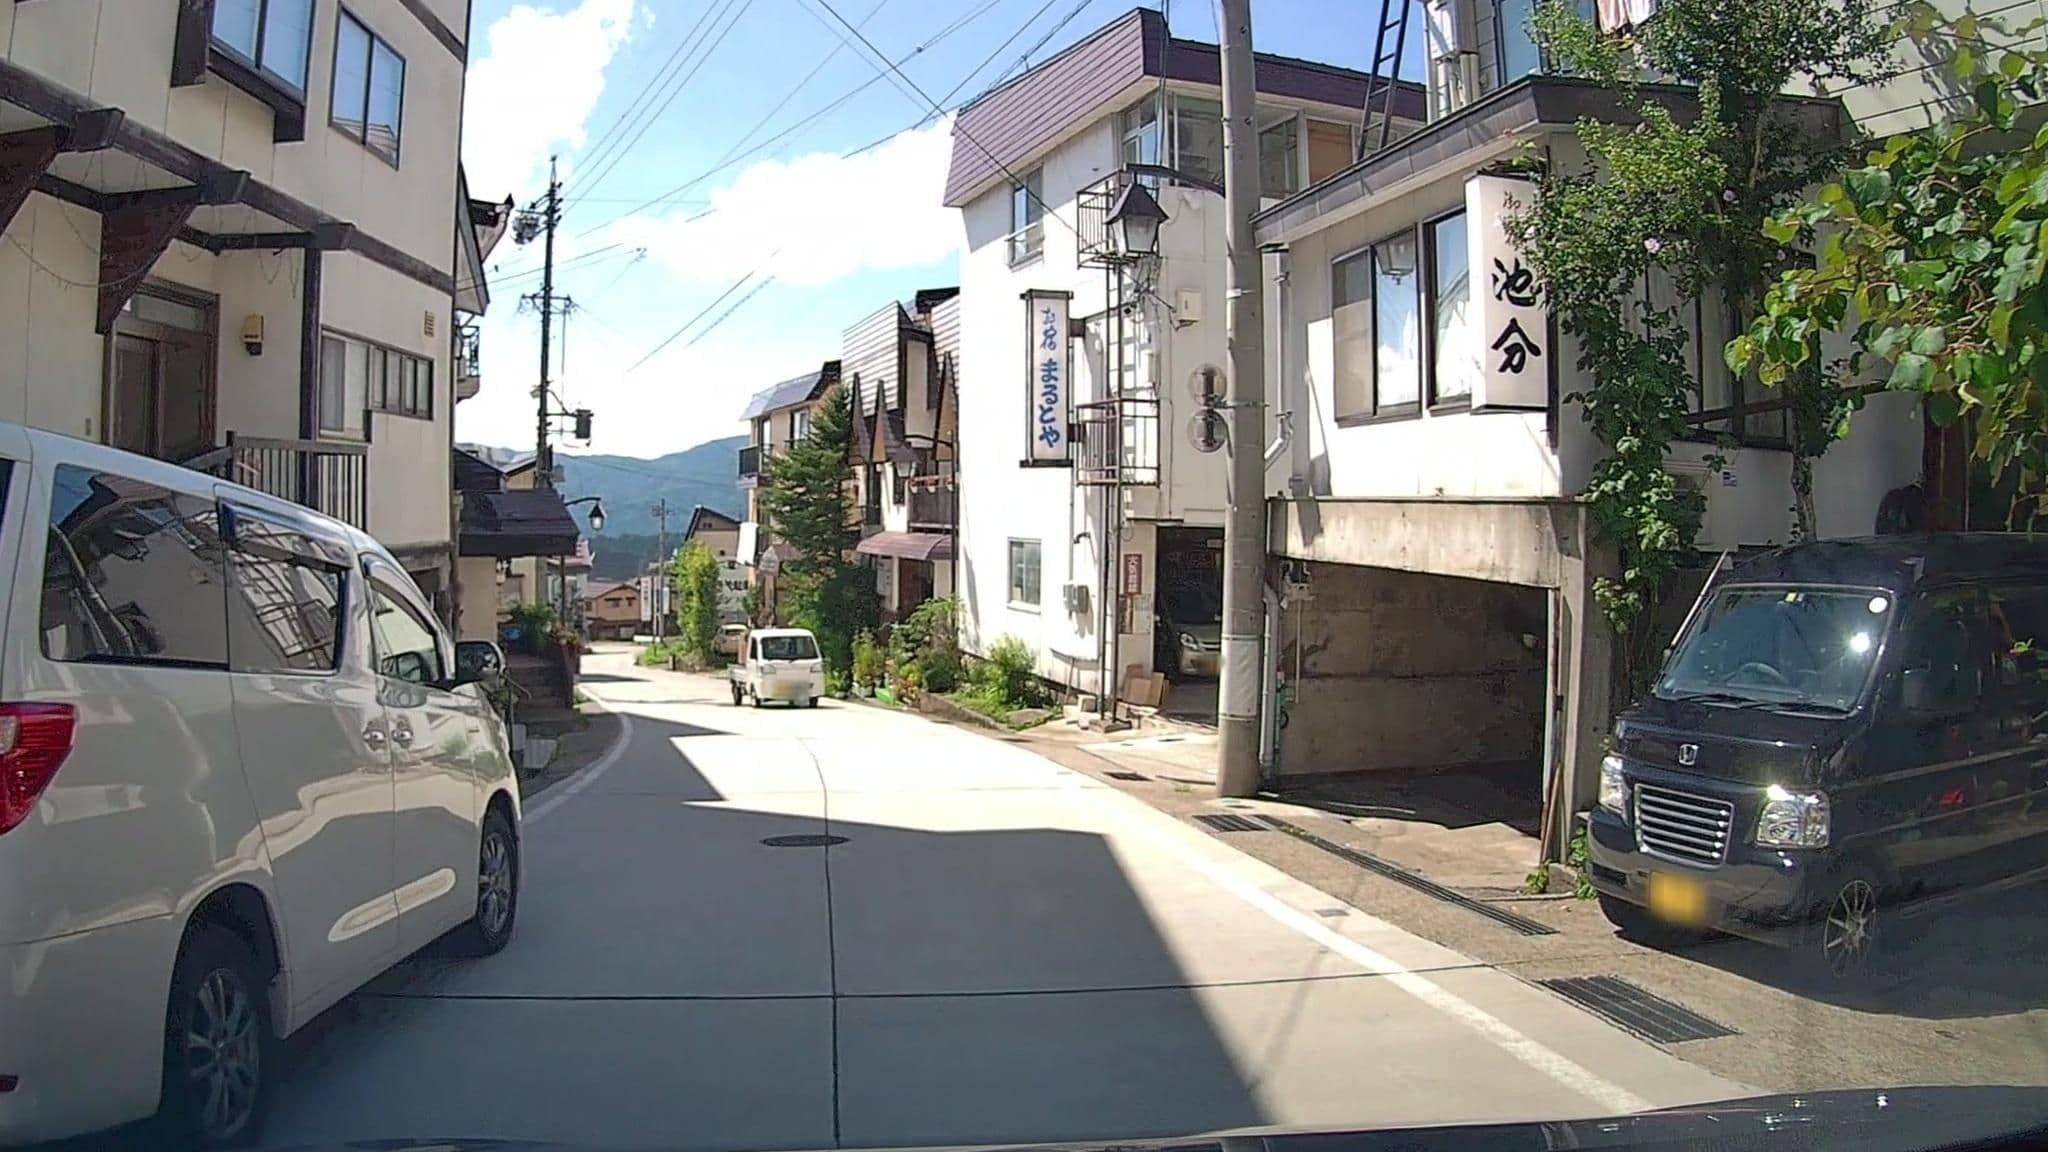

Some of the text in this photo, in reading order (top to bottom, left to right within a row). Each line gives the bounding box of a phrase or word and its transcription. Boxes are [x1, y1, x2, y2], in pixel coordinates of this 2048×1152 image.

[1490, 256, 1543, 375] 池分
[1039, 357, 1061, 448] まるとや
